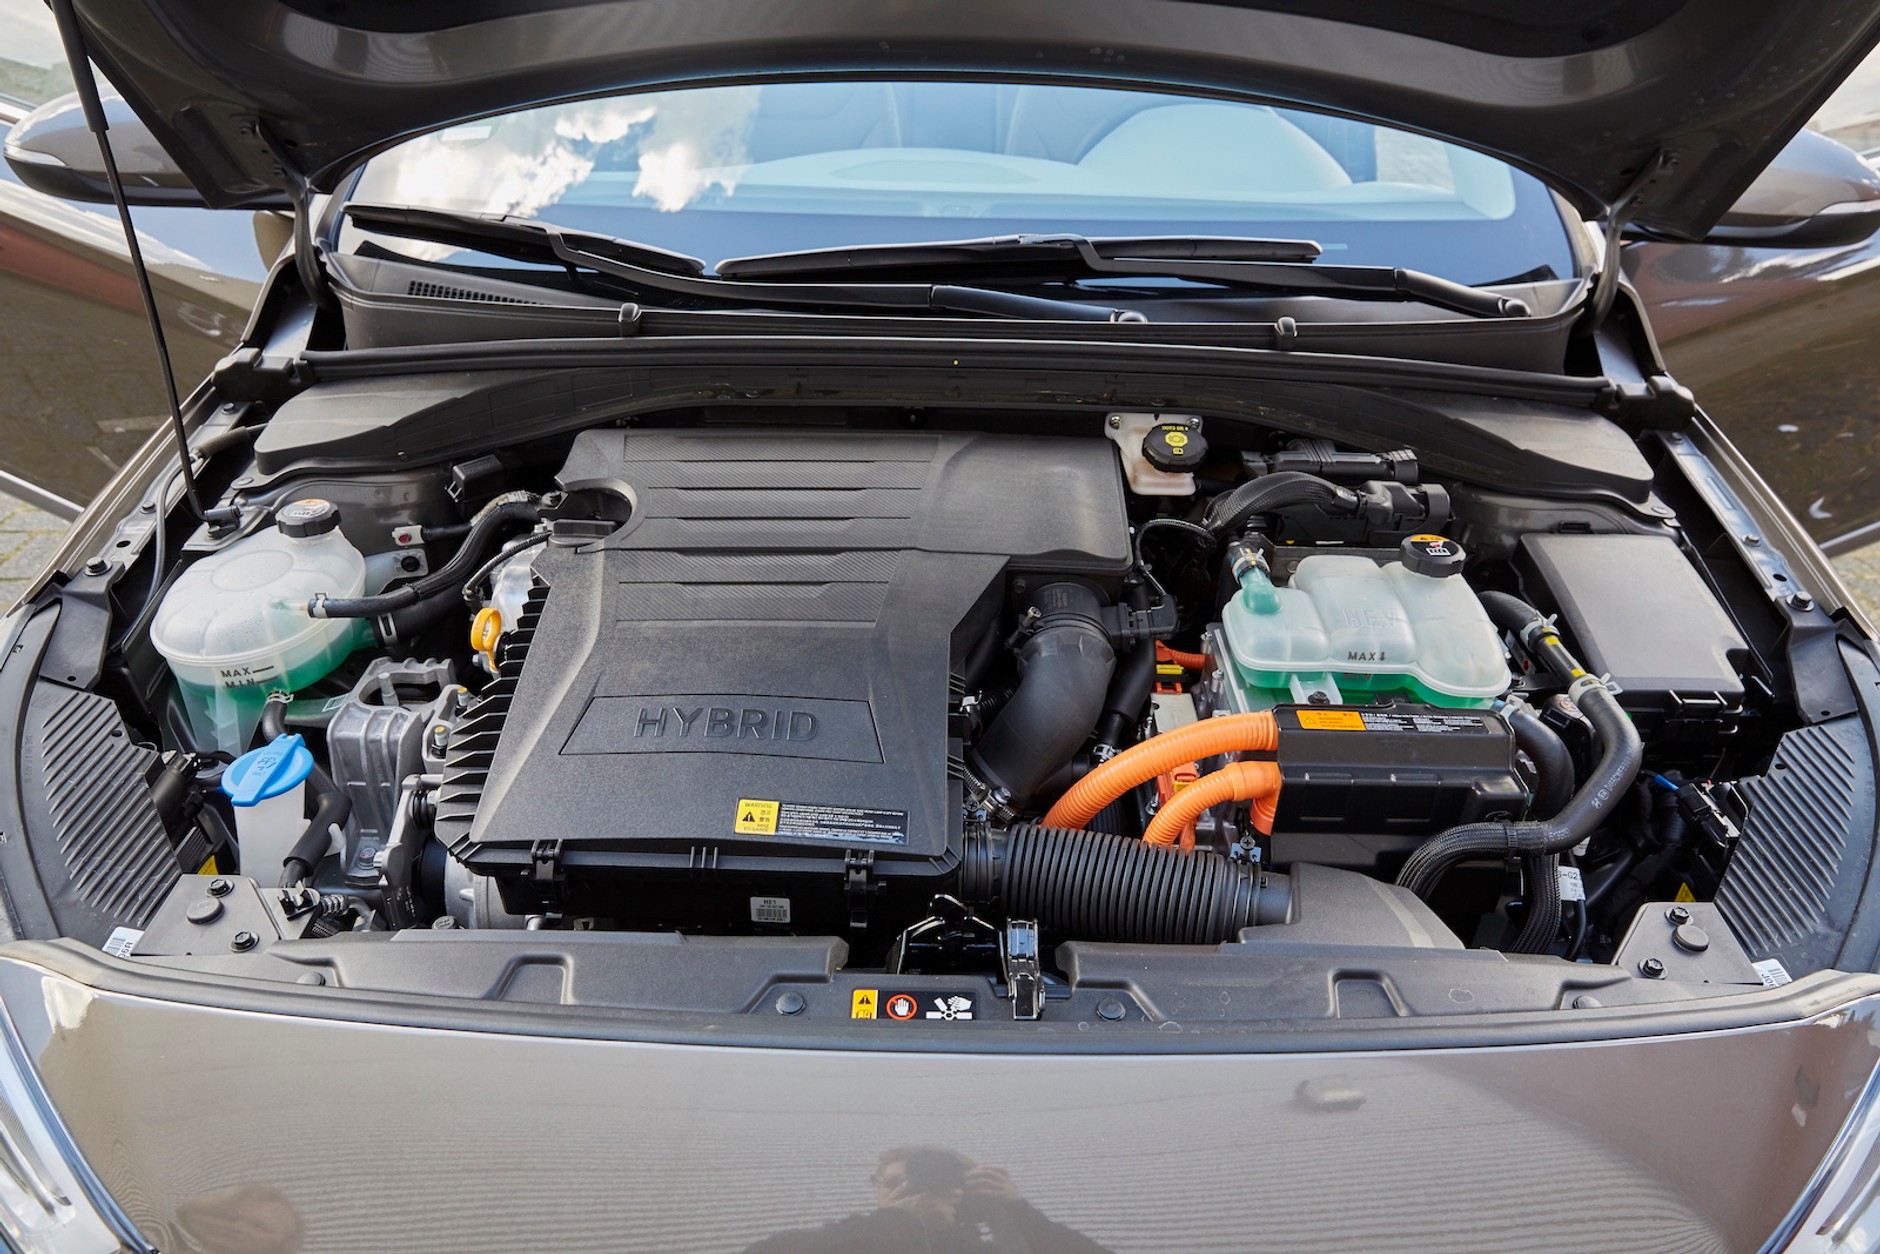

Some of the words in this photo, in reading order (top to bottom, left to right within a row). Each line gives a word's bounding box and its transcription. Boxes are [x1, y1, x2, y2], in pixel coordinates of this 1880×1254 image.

[1347, 651, 1376, 661] MAX
[220, 667, 251, 678] MAX
[225, 678, 255, 688] MIN
[633, 707, 819, 741] HYBRID
